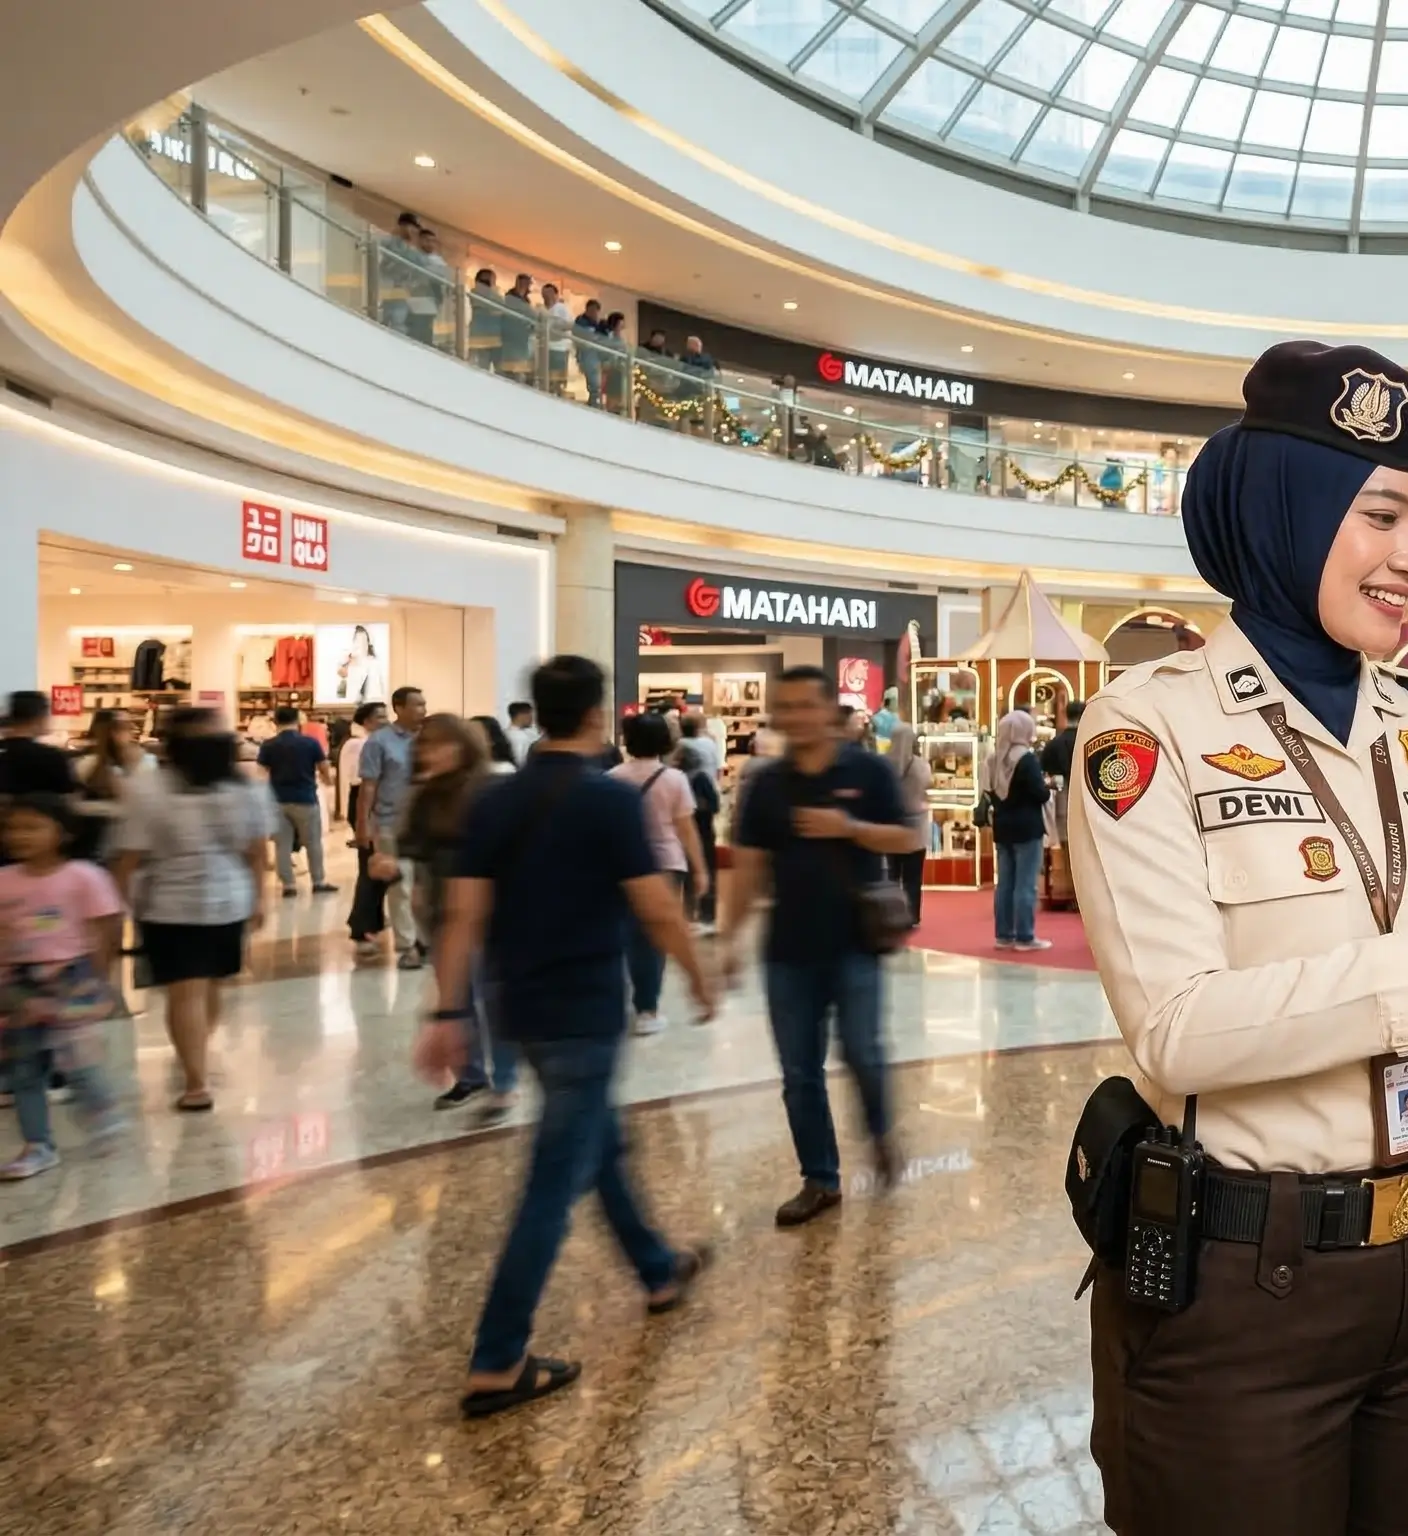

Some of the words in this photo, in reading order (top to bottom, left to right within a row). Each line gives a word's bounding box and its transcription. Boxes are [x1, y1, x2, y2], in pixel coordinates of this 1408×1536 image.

[844, 361, 974, 406] MATAHARI
[293, 518, 323, 543] UNI
[293, 540, 326, 566] QLO
[723, 586, 877, 629] MATAHARI
[1219, 794, 1305, 820] DEWI
